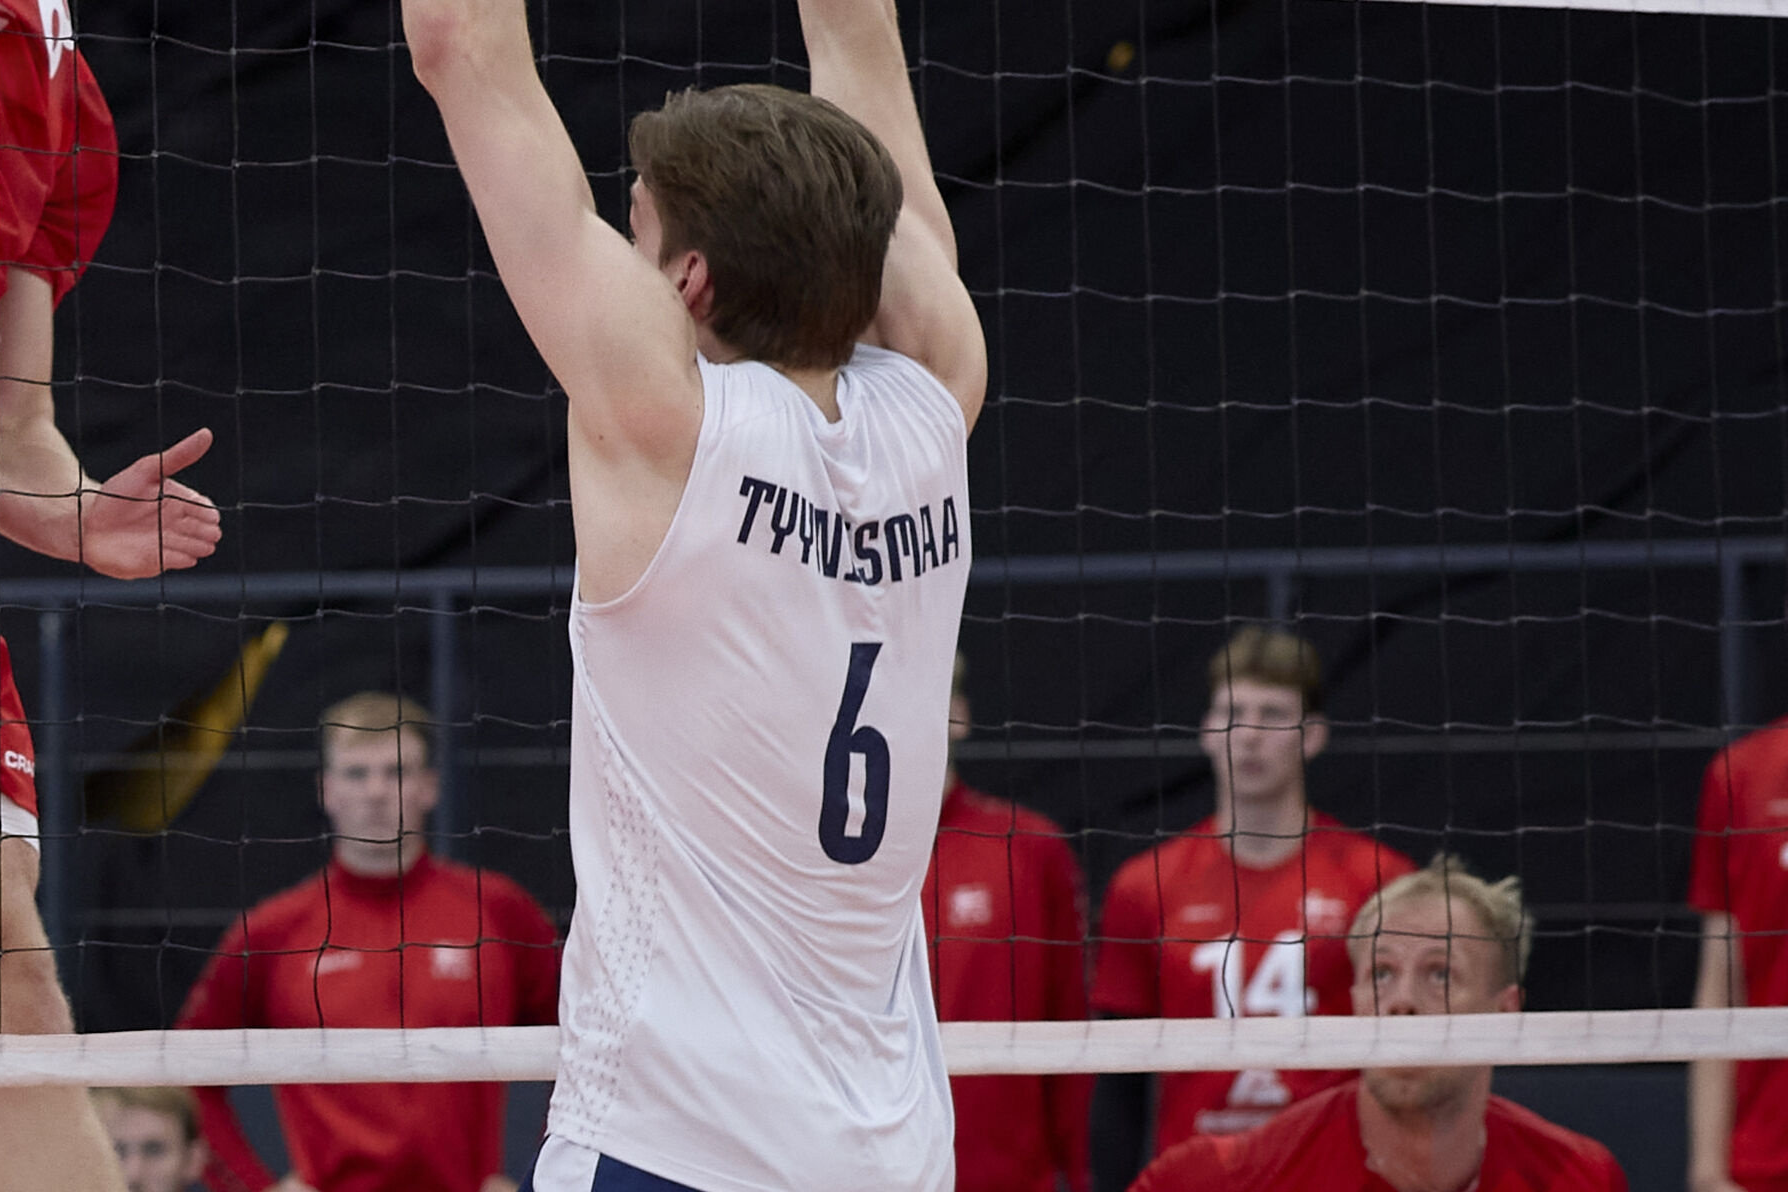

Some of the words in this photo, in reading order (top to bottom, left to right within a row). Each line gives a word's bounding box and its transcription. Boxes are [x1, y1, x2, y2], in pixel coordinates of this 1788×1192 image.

[737, 475, 960, 586] TYYNSMAA
[818, 642, 891, 865] 6
[1190, 930, 1319, 1019] 14
